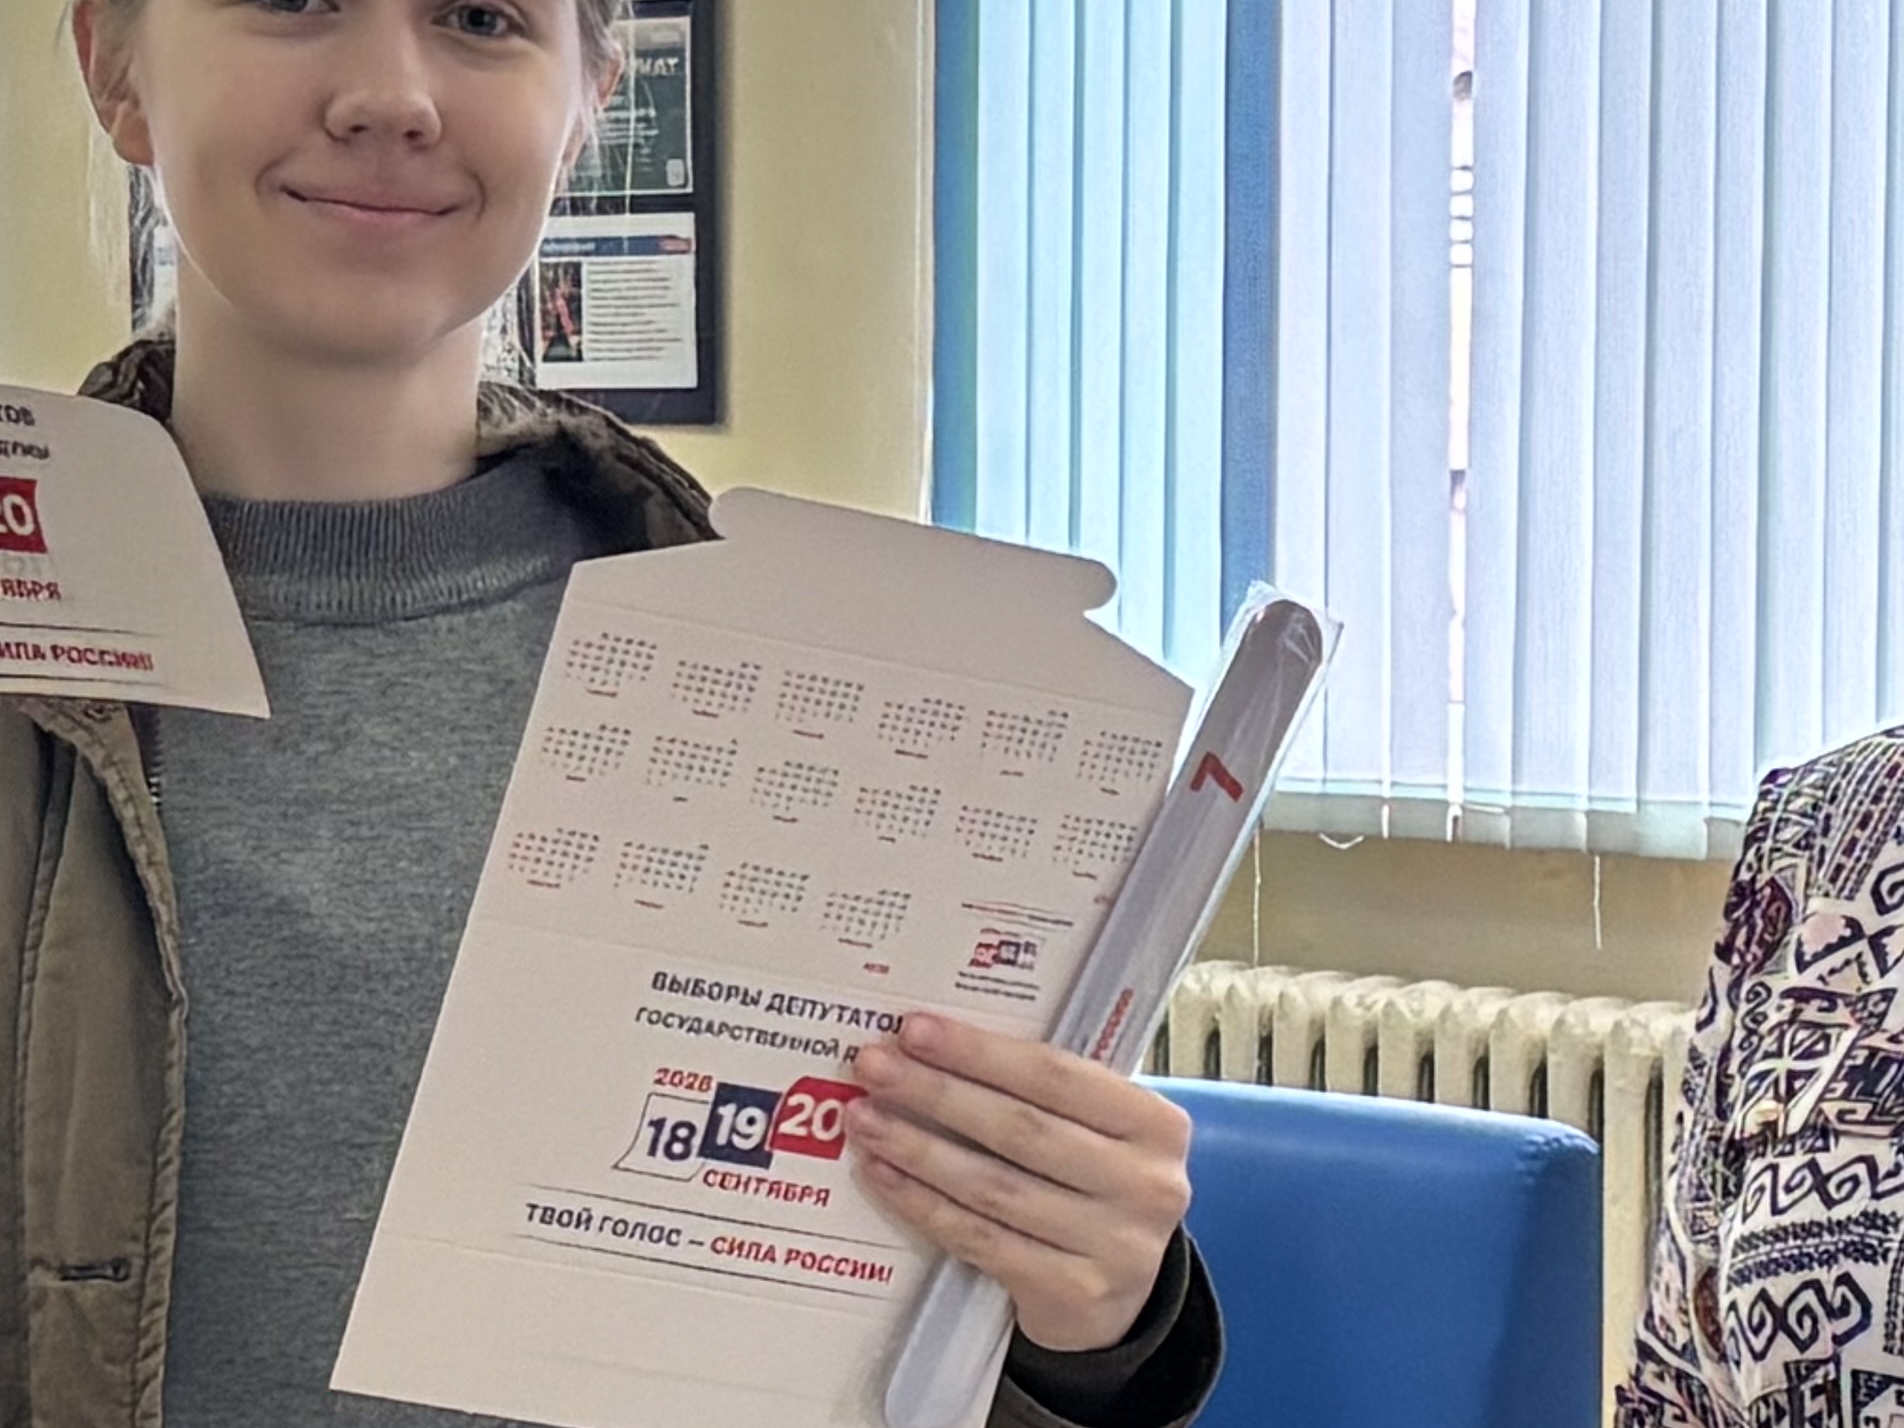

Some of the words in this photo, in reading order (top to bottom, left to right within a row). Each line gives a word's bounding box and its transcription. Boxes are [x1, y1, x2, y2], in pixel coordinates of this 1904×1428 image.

[651, 971, 763, 1006] ВЫБОРЫ
[635, 1006, 840, 1058] ГОСУДАРСТВЕННОЙ
[647, 1116, 697, 1161] 18
[715, 1103, 768, 1150] 19
[778, 1092, 843, 1142] 20
[702, 1169, 830, 1207] СЕНТЯБРЯ
[526, 1203, 594, 1232] ТВОЙ
[598, 1215, 682, 1247] ГОЛОС
[710, 1236, 777, 1263] СИЛА
[784, 1248, 894, 1284] РОССИИ!
